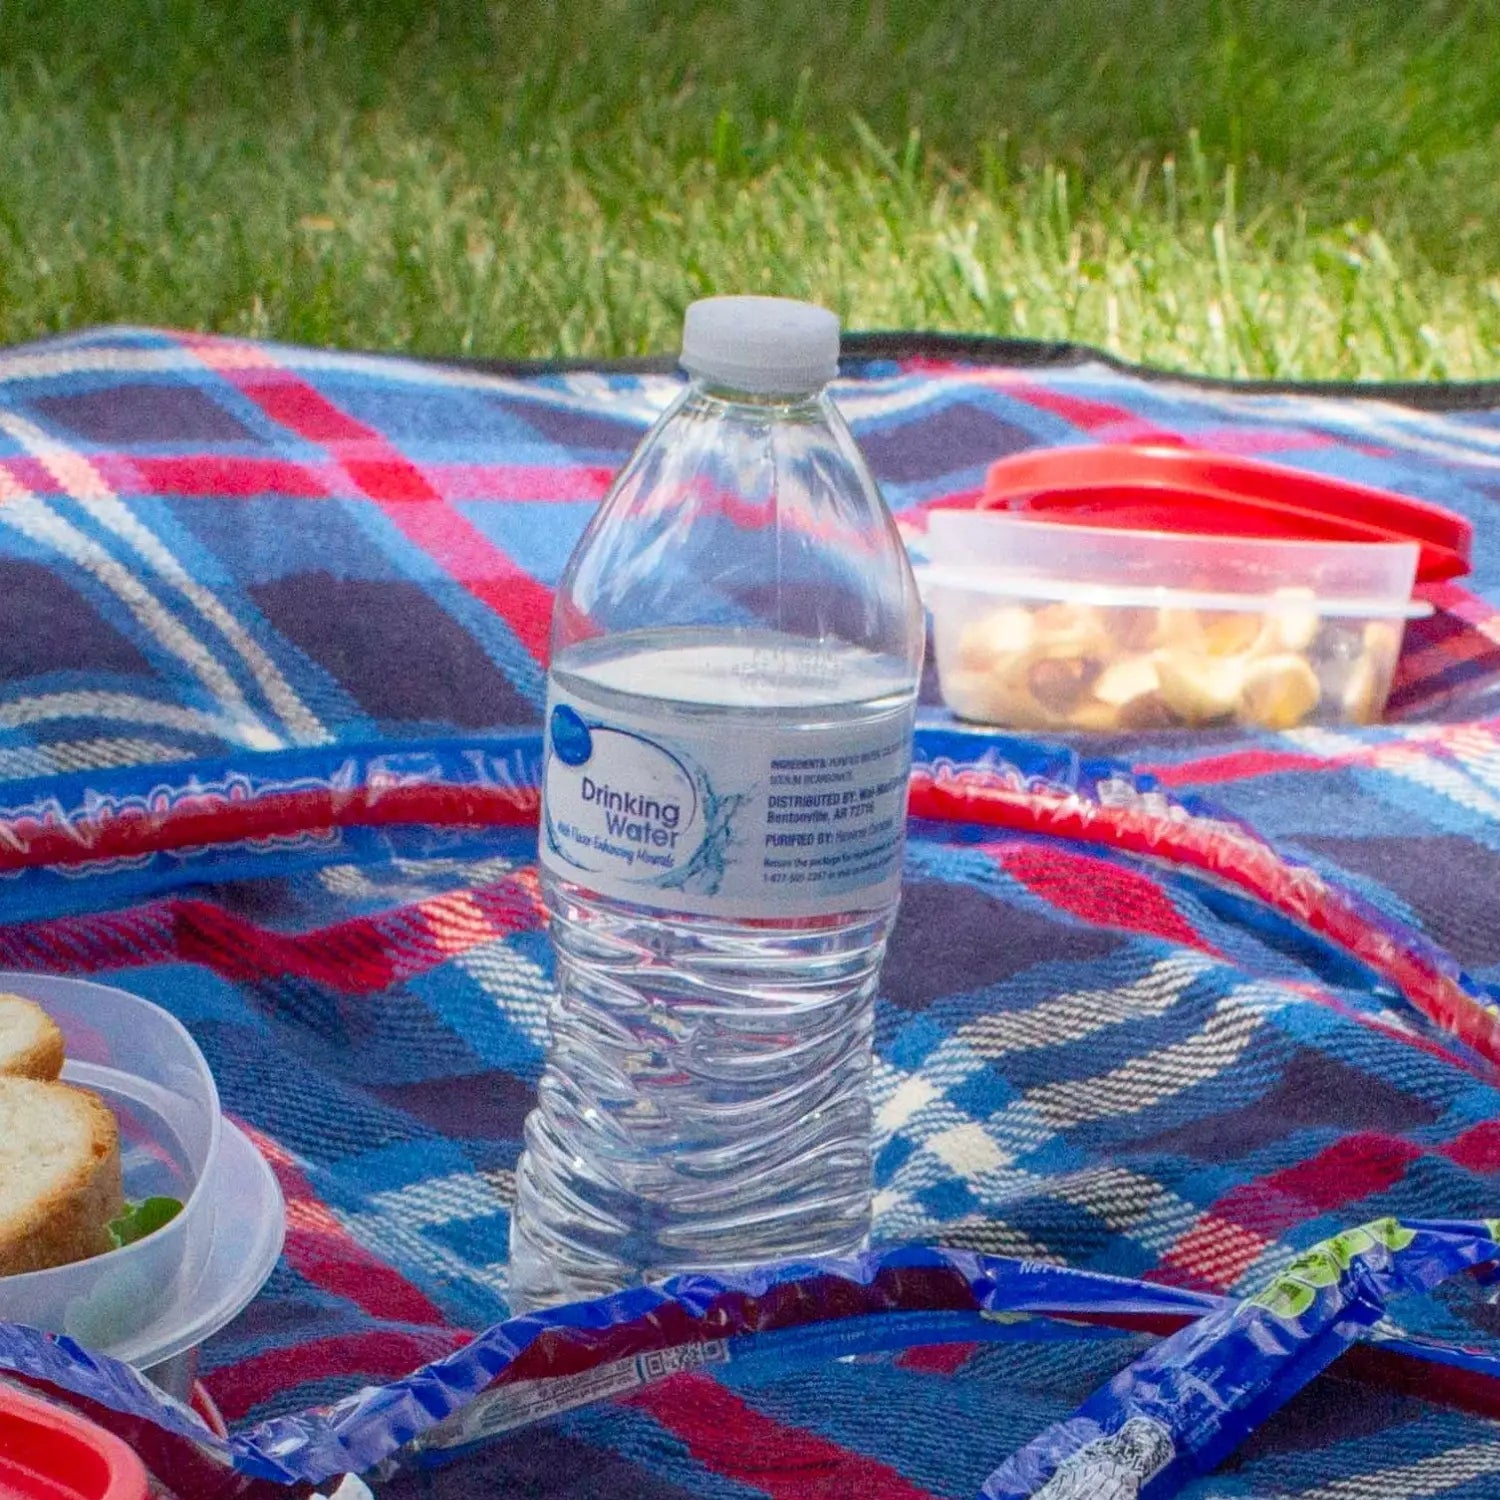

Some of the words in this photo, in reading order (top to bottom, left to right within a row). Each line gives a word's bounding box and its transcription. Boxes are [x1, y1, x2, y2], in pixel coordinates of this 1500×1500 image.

[582, 776, 680, 829] Drinking
[768, 793, 841, 809] DISTRIBUTED
[606, 810, 679, 849] Water
